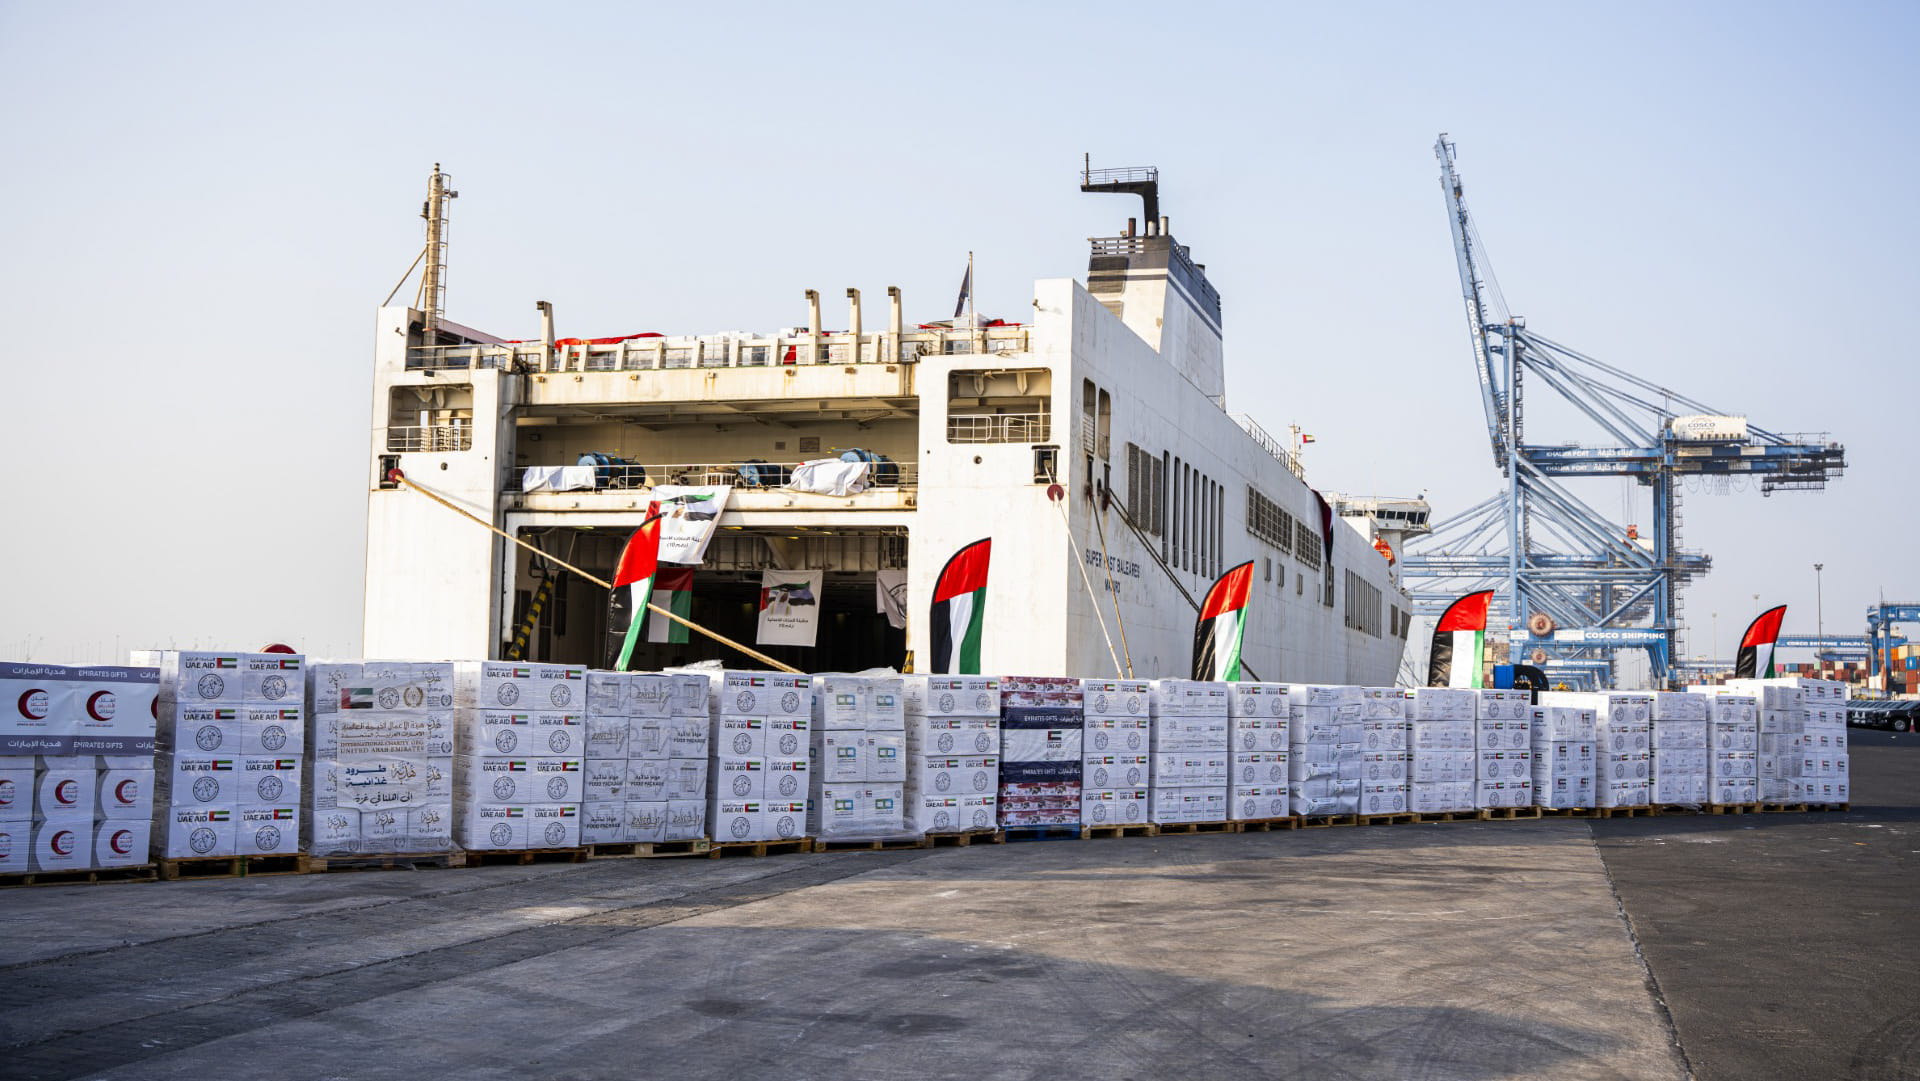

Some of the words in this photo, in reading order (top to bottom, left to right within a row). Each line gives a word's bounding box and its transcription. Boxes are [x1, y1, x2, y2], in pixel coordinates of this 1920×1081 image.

[1086, 548, 1102, 568] SUPER
[1116, 558, 1140, 578] BALEARES
[346, 764, 386, 775] طرود
